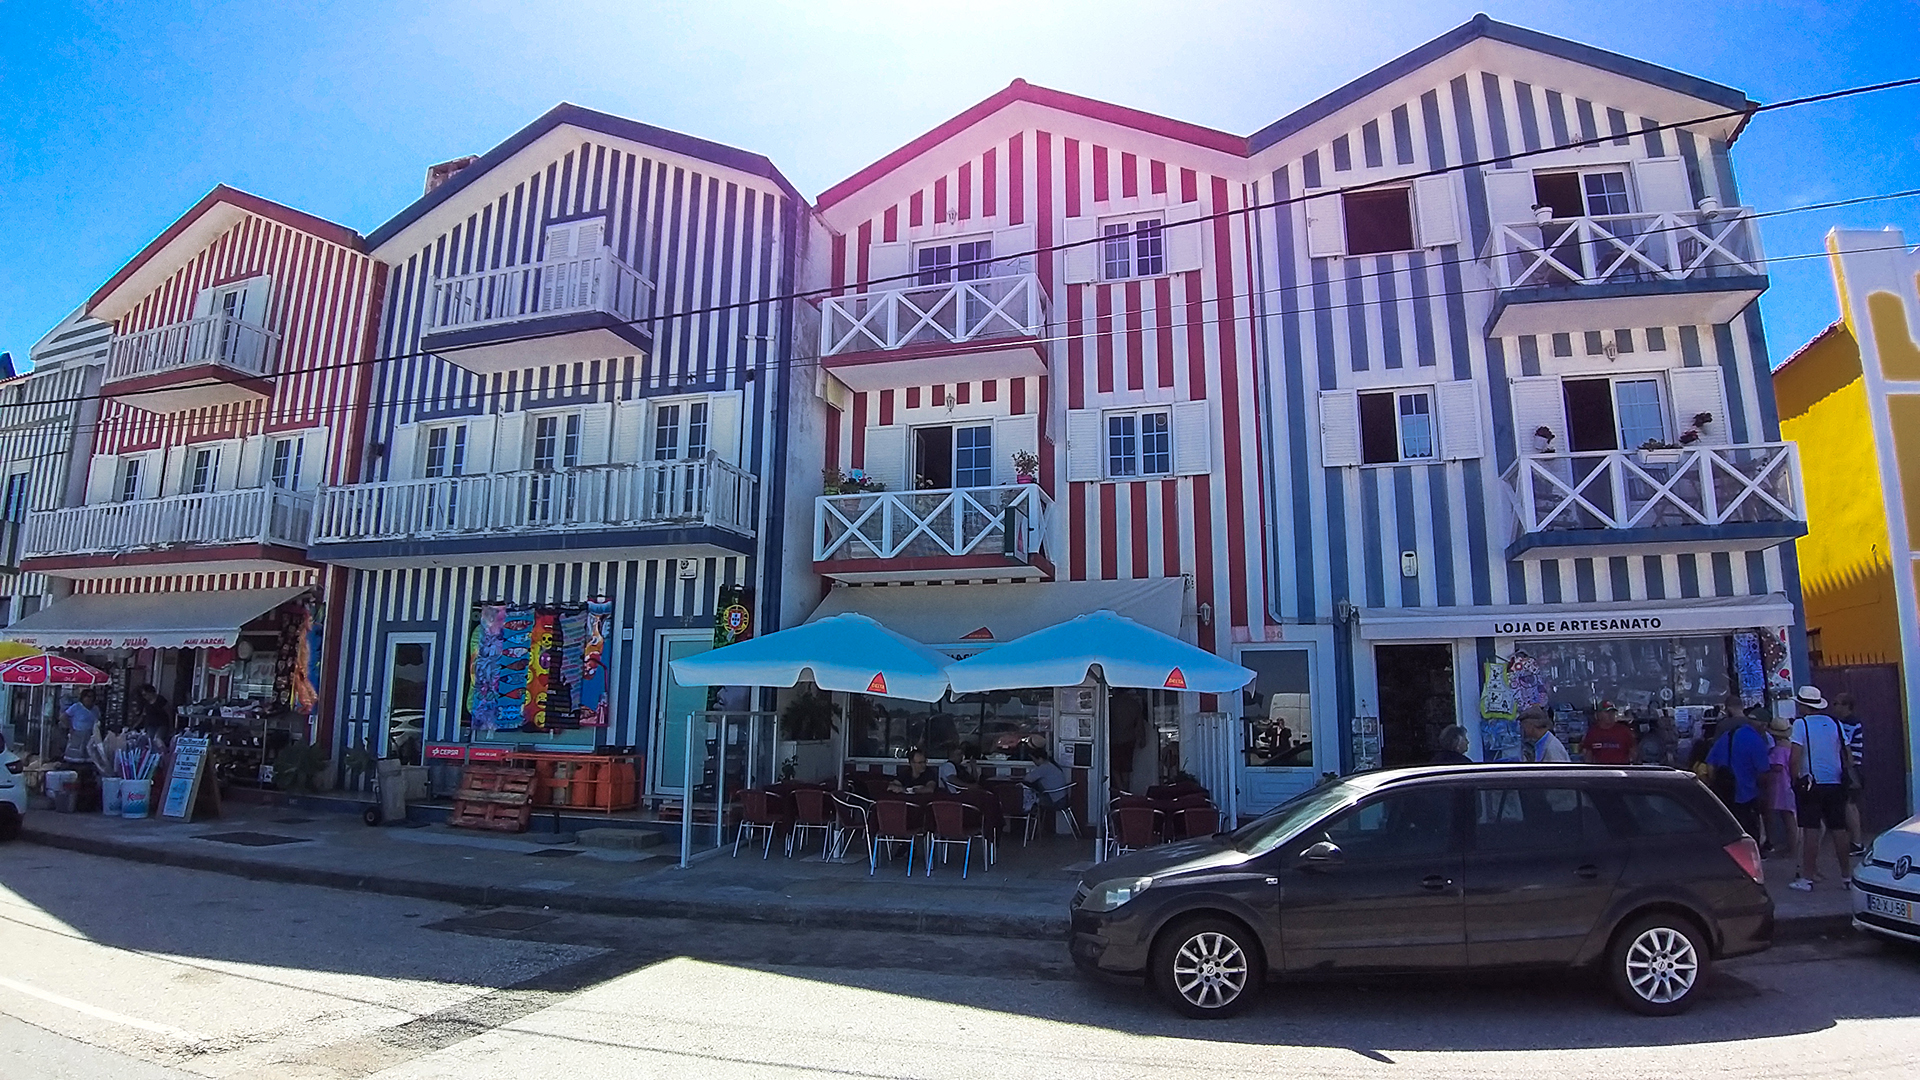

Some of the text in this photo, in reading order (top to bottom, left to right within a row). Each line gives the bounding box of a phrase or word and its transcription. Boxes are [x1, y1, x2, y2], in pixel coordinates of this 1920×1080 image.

[1494, 617, 1662, 634] LOJA DE ARTESANATO
[66, 638, 113, 646] MINI-MERCADO
[122, 636, 149, 647] JULIÃO
[440, 748, 459, 756] CEPSA
